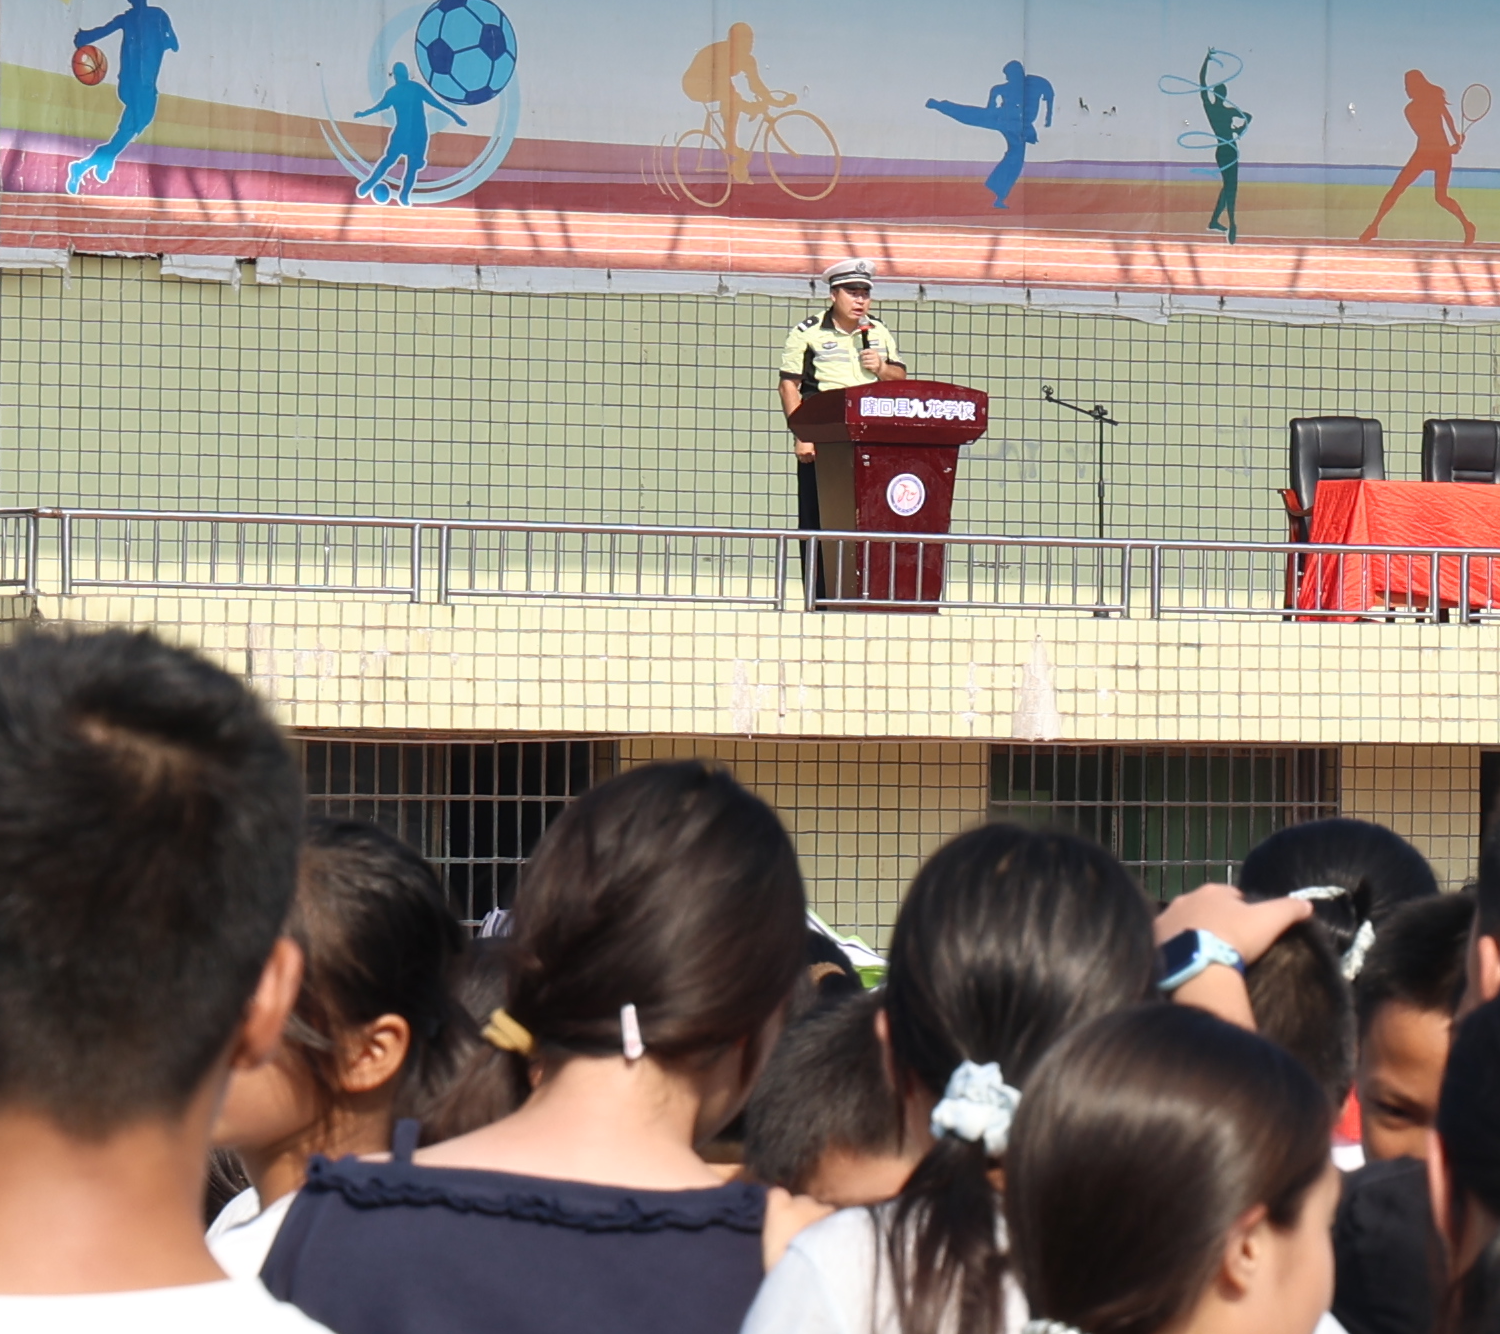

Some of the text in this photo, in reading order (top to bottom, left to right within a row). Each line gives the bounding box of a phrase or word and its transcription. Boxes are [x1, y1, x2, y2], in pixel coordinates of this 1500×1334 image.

[860, 397, 976, 420] 隆回县九龙学校
